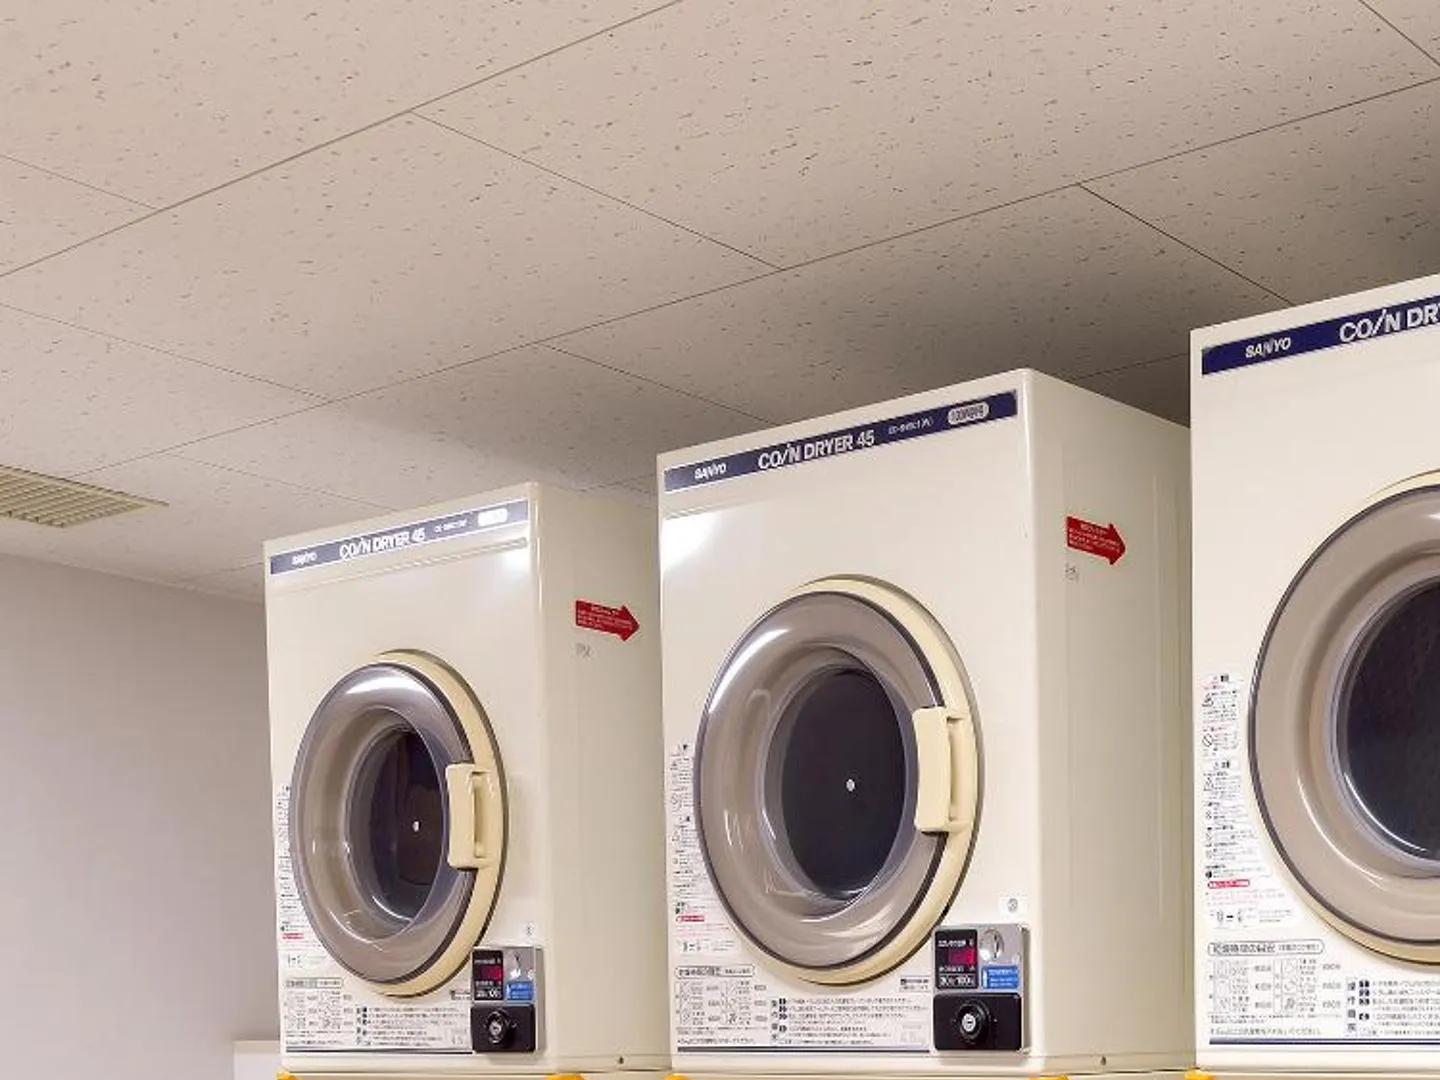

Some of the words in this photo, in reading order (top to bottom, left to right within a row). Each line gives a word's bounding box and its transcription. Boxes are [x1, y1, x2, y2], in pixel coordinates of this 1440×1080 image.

[1244, 336, 1292, 358] SANYO
[803, 434, 854, 462] DRYER
[857, 429, 875, 449] 45
[372, 531, 410, 554] DRYER
